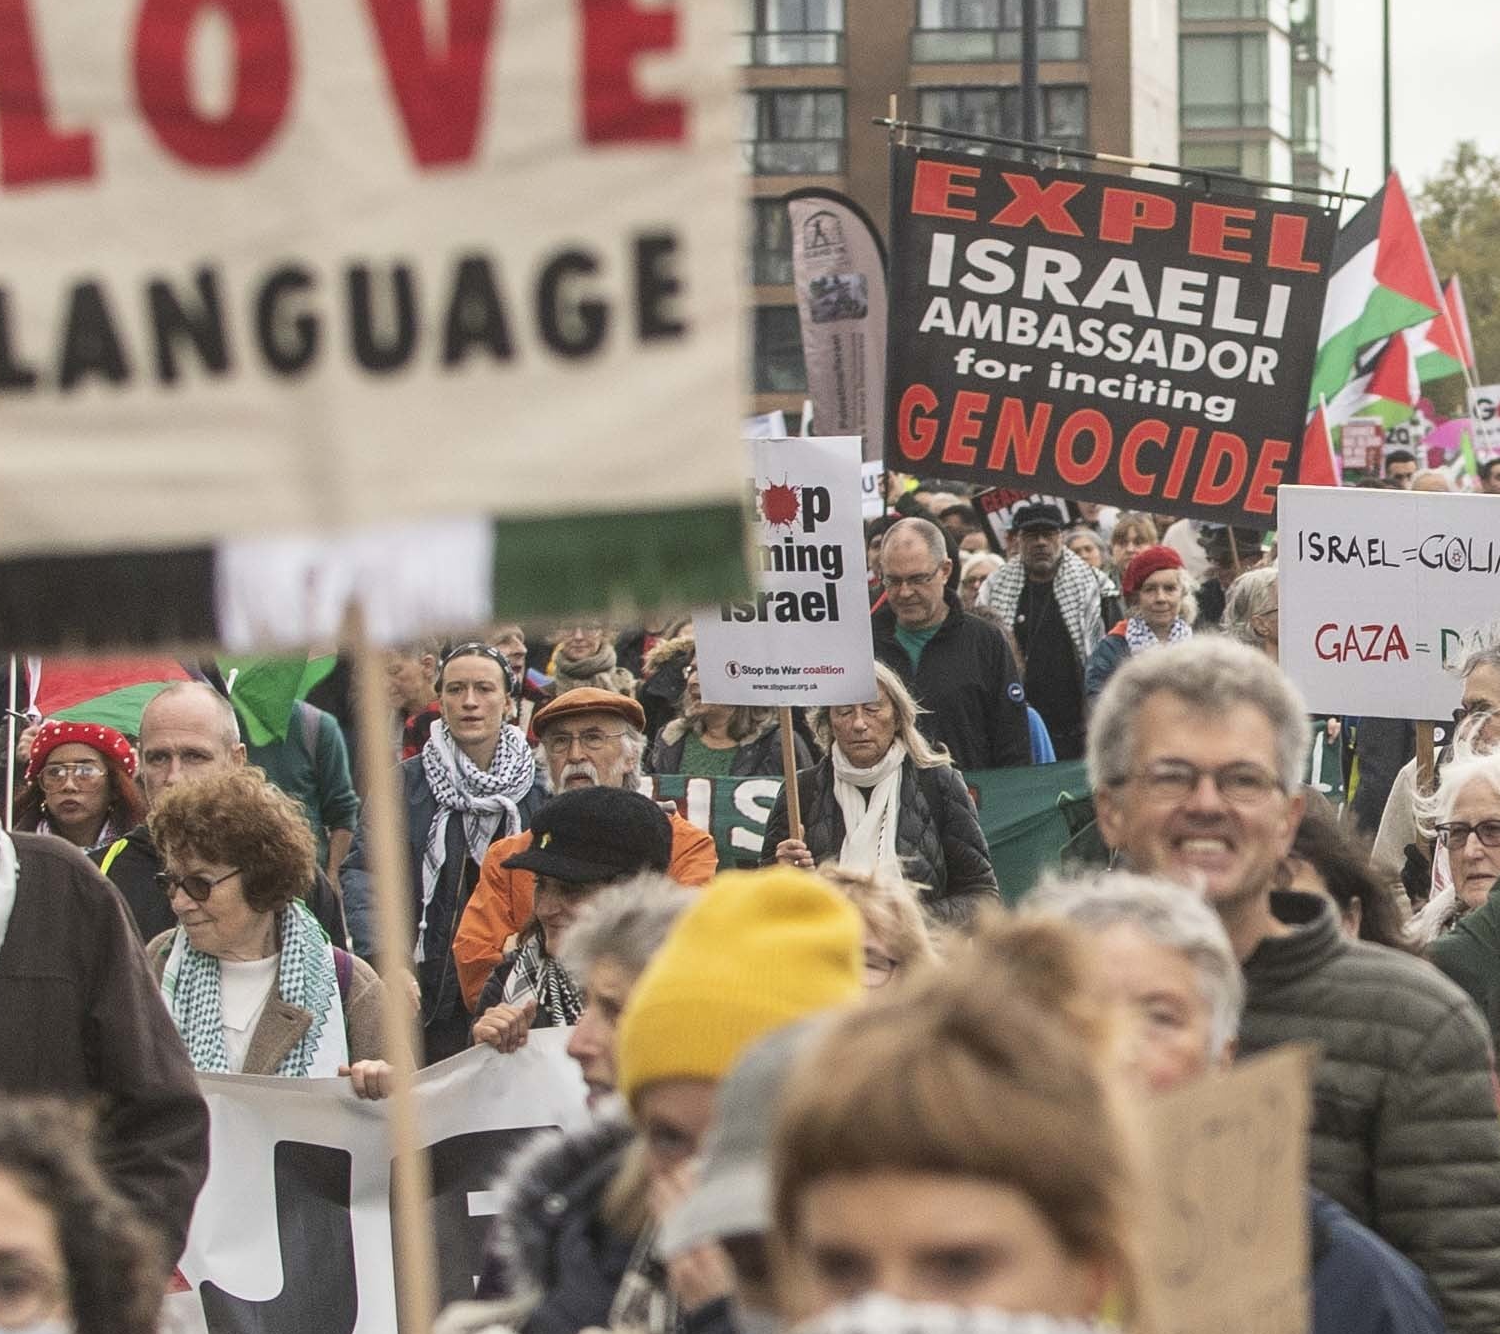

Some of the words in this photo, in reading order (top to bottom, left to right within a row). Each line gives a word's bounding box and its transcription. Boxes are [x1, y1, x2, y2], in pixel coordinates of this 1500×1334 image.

[910, 158, 1322, 274] EXPEL
[927, 231, 1292, 340] ISRAELI
[918, 296, 1280, 386] AMBASSADOR
[953, 347, 1033, 383] for
[1047, 362, 1237, 423] inciting
[898, 383, 1293, 515] GENOCIDE
[756, 536, 844, 581] ming
[741, 665, 764, 677] Stop
[765, 665, 780, 676] the
[781, 665, 802, 676] War
[803, 664, 845, 676] coalition
[1315, 623, 1410, 663] GAZA
